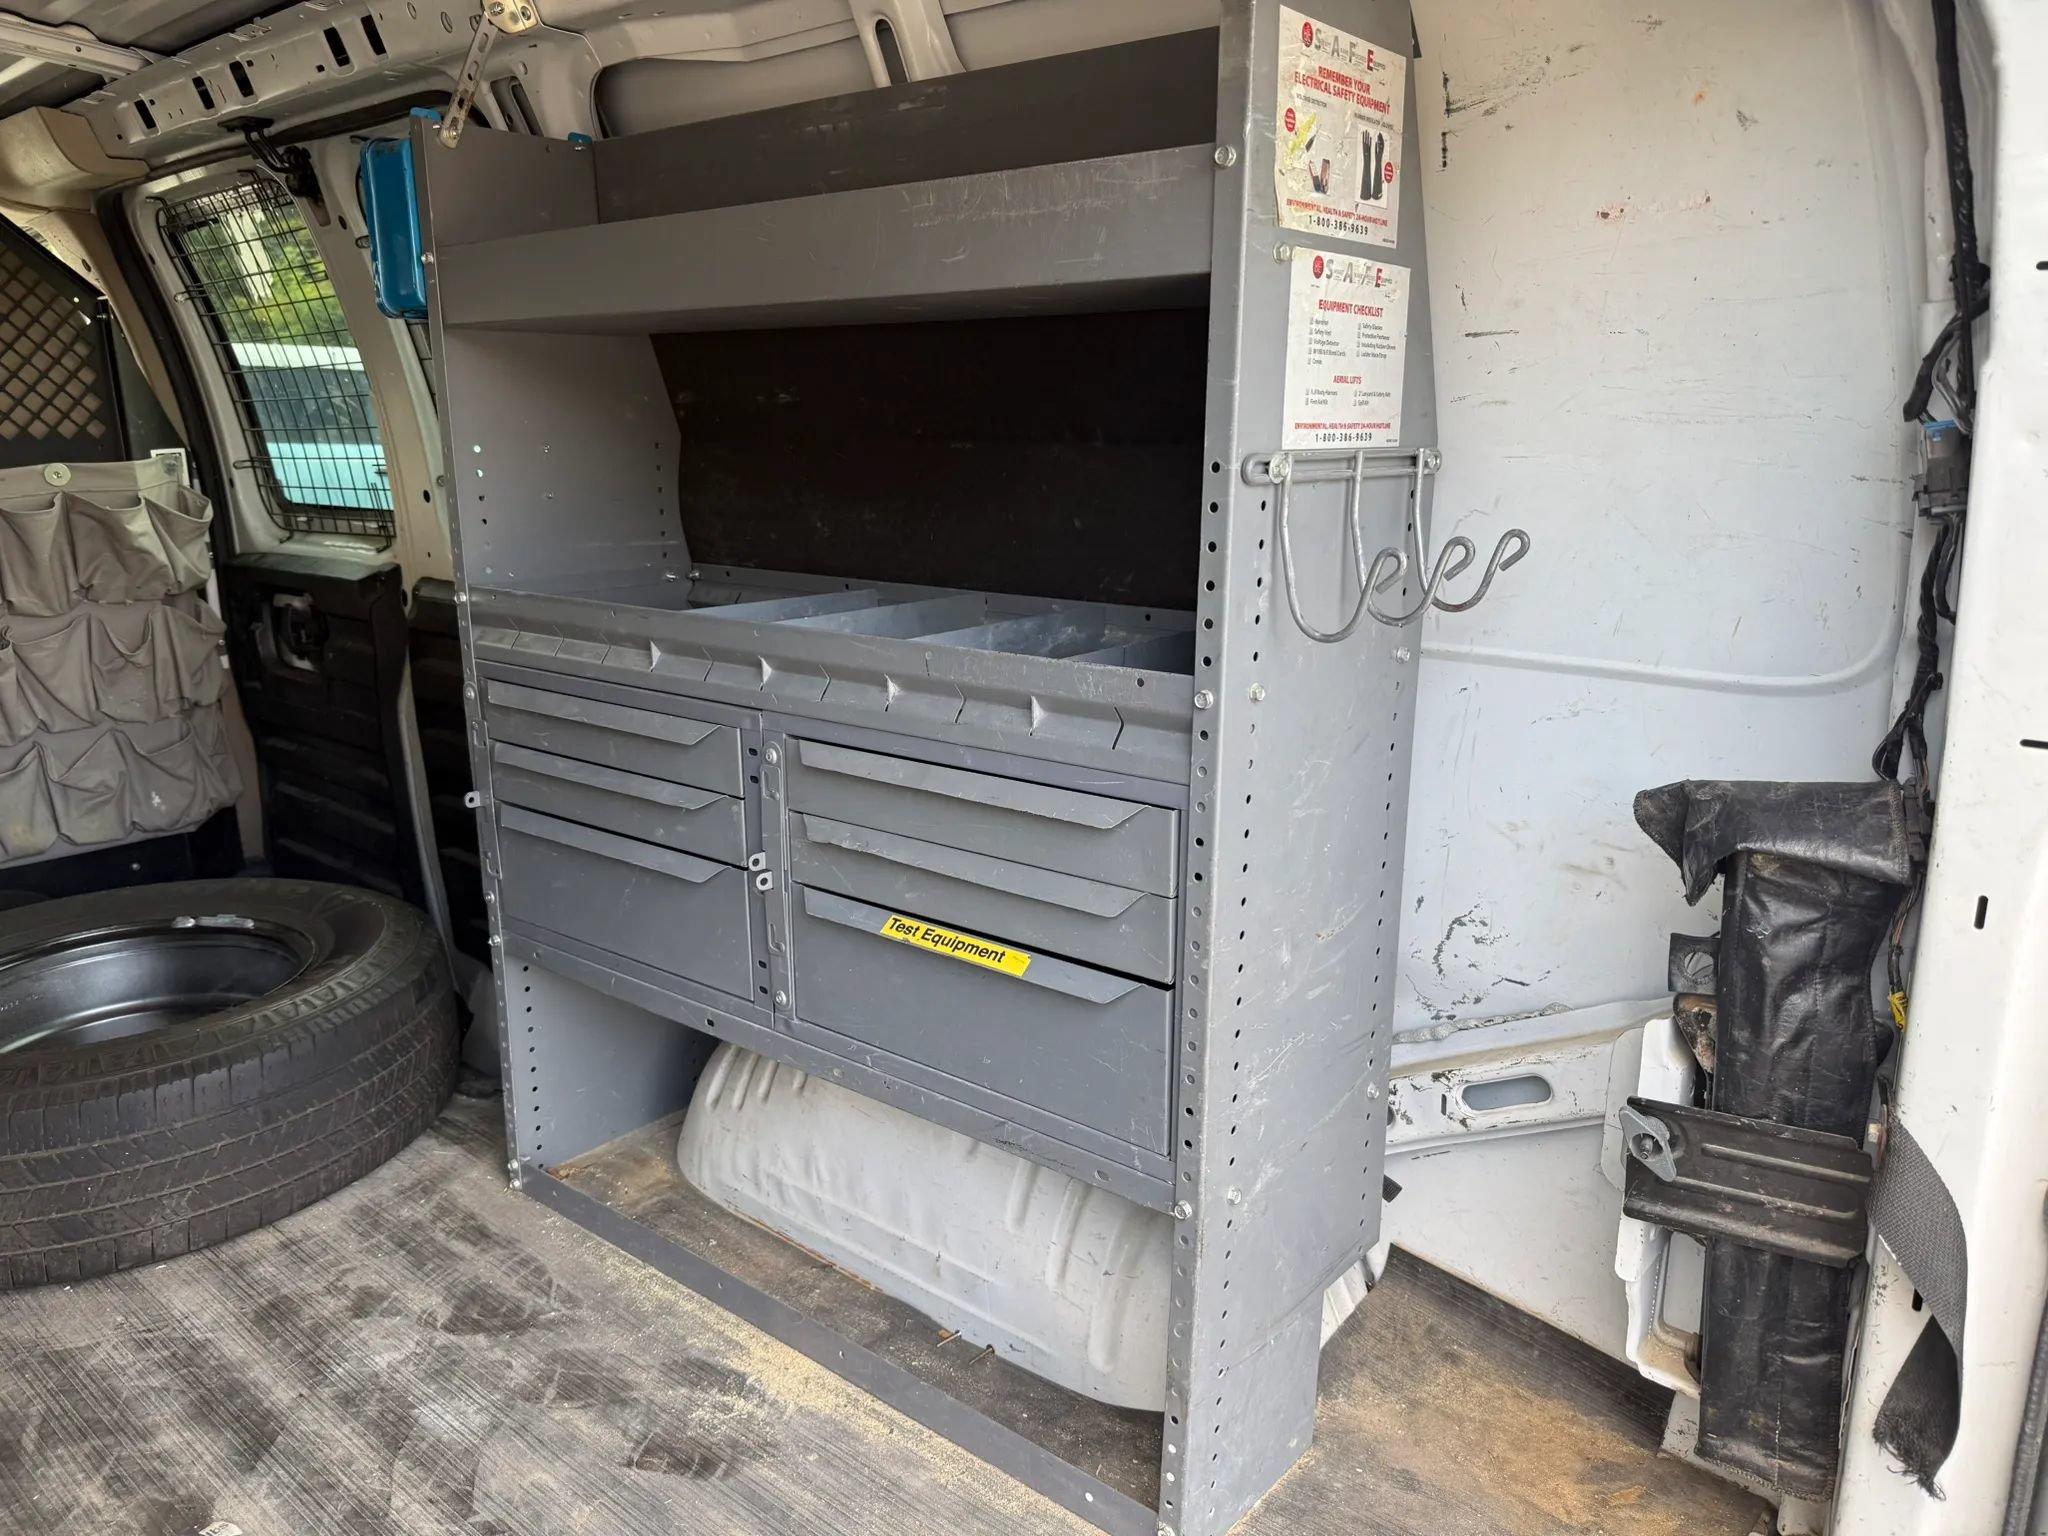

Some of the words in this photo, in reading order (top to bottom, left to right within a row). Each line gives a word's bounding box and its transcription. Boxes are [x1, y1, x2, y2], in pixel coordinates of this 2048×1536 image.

[1318, 65, 1353, 89] REMEMBER
[1353, 78, 1371, 95] YOUR
[1294, 71, 1332, 95] ELECTRICAL
[1332, 84, 1356, 104] SAFETY
[1356, 93, 1391, 115] EQUIPMENT
[1286, 198, 1322, 213] ENVIRONMENTAL
[1323, 207, 1338, 216] HEALTH
[1341, 210, 1355, 219] SAFETY
[1318, 299, 1353, 314] EQUIPMENT
[1353, 304, 1384, 318] CHECKLIST
[1333, 375, 1350, 384] AERIAL
[1350, 376, 1362, 385] LIFTS
[1294, 422, 1328, 430] ENVIRONMENTAL
[1329, 422, 1343, 430] HEALTH
[1347, 422, 1360, 430] SAFETY
[1315, 432, 1372, 443] 1-800-386-9639
[888, 917, 921, 938] Test
[920, 927, 1006, 964] Equipment
